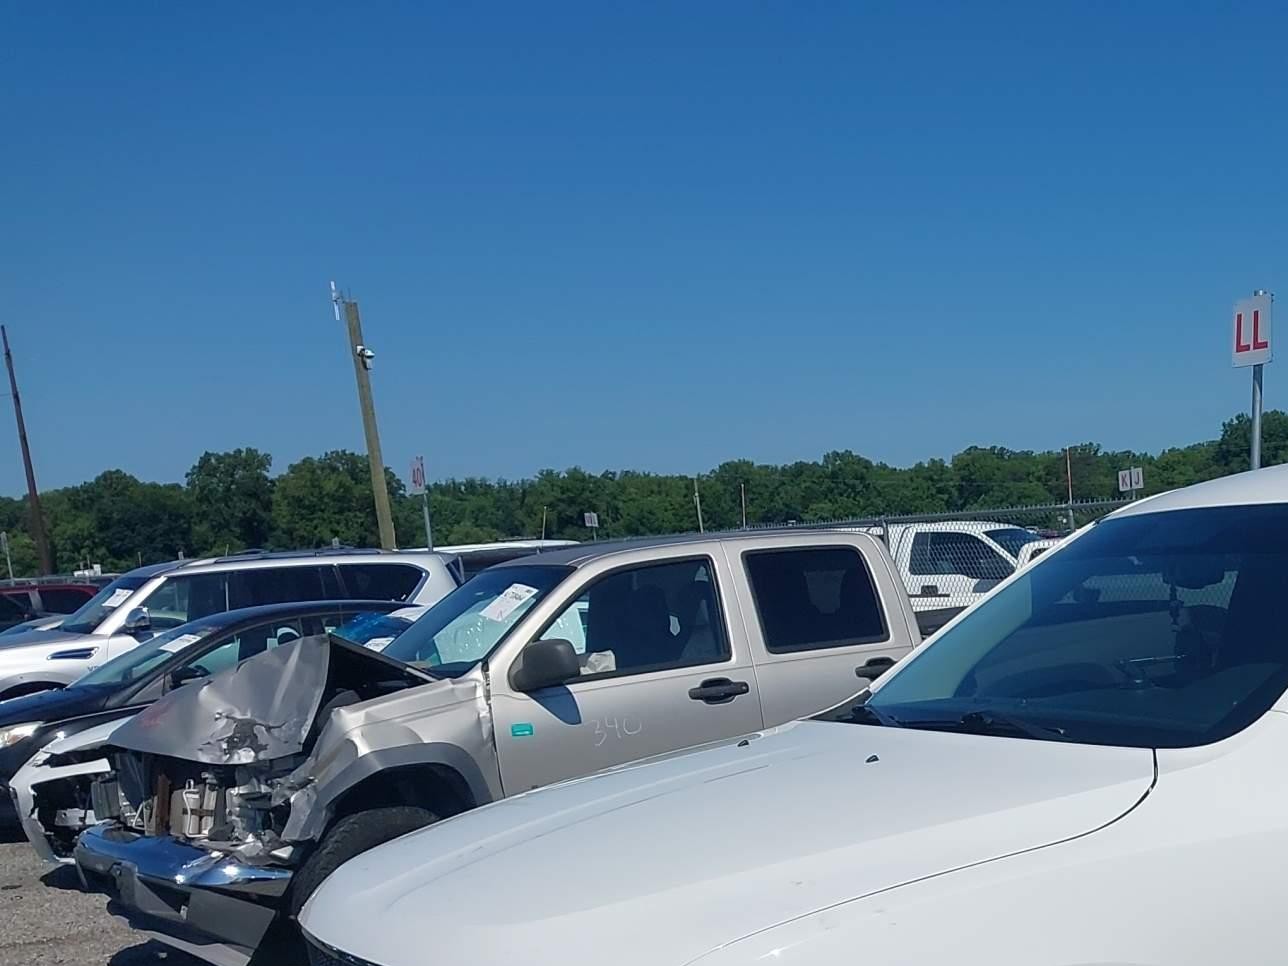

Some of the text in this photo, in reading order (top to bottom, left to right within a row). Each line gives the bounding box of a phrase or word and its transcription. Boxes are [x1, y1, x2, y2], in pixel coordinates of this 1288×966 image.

[1236, 310, 1268, 353] LL
[1121, 473, 1129, 488] K
[585, 715, 643, 747] 340
